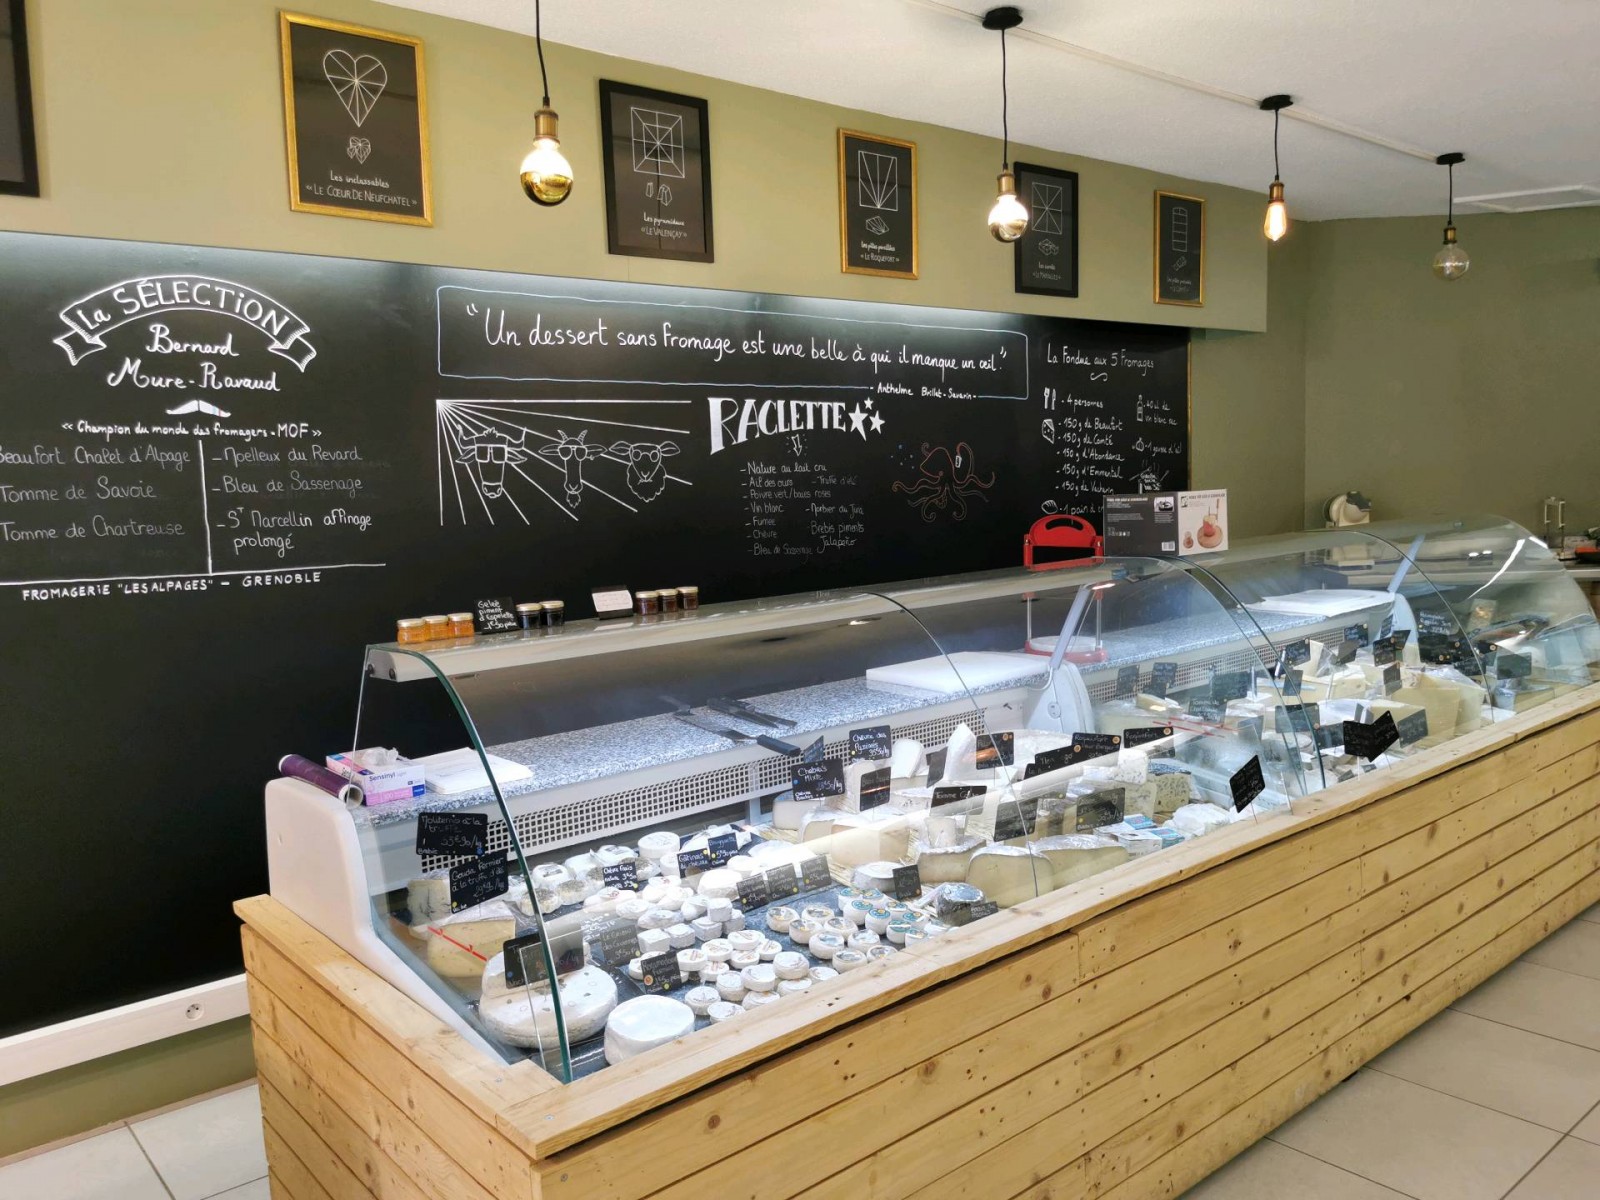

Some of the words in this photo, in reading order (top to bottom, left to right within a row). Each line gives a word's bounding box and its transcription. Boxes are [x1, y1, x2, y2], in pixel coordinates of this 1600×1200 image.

[330, 170, 343, 182] Les
[346, 175, 390, 188] inclassables
[352, 190, 363, 201] DE
[77, 305, 111, 331] La
[146, 324, 239, 356] Bernard
[529, 313, 608, 346] dessert
[616, 329, 657, 347] sans
[662, 322, 736, 362] fromage
[743, 330, 765, 354] est
[772, 341, 806, 358] une
[810, 336, 850, 361] belle
[852, 344, 866, 361] à
[870, 350, 891, 374] qui
[899, 344, 909, 362] il
[912, 352, 958, 383] manque
[961, 358, 976, 370] un
[1047, 343, 1059, 363] La
[1063, 346, 1091, 366] Fondue
[1094, 356, 1107, 366] aux
[1111, 353, 1118, 367] 5
[1121, 348, 1154, 376] Fromages
[877, 382, 914, 396] Anthelme
[1067, 393, 1072, 403] 4
[1162, 401, 1171, 411] de
[707, 397, 846, 455] RACLETTE
[1084, 418, 1092, 430] de
[1094, 416, 1123, 432] Beaufort
[1154, 415, 1167, 424] blanc
[77, 420, 131, 441] Champion
[135, 423, 149, 434] du
[151, 425, 189, 436] monde
[192, 423, 210, 435] des
[213, 423, 268, 441] fromagers
[278, 422, 309, 439] MOF
[1083, 434, 1092, 445] de
[1093, 434, 1114, 446] Comté
[74, 446, 120, 465] Chalet
[129, 445, 190, 472] d'Alpage
[225, 446, 280, 472] Moelleux
[288, 448, 307, 461] du
[311, 445, 363, 461] Revard
[747, 461, 776, 475] Nature
[794, 462, 811, 474] lait
[814, 463, 827, 472] cru
[0, 485, 60, 503] Tomme
[65, 485, 87, 500] de
[96, 475, 157, 500] Savoie
[223, 475, 259, 493] Bleu
[266, 480, 285, 493] de
[290, 470, 363, 498] Sassenage
[749, 476, 762, 488] Ail
[765, 477, 776, 488] des
[777, 479, 793, 488] ours
[1080, 482, 1089, 493] de
[750, 490, 773, 500] Poivre
[815, 489, 832, 498] roses
[750, 502, 763, 514] Vin
[764, 502, 785, 514] blanc
[811, 503, 836, 517] Morbier
[839, 505, 848, 513] du
[850, 503, 864, 519] Jura
[1071, 503, 1088, 515] pain
[252, 510, 313, 529] Marcellin
[323, 508, 373, 532] affinage
[0, 521, 59, 542] Tomme
[65, 522, 87, 539] de
[92, 515, 185, 537] Chartreuse
[752, 529, 777, 540] Chèvre
[810, 520, 835, 535] Brebis
[838, 522, 864, 538] piments
[234, 532, 295, 558] prolongé
[753, 543, 772, 556] Bleu
[773, 546, 781, 554] de
[242, 572, 321, 588] GRENOBLE
[478, 600, 501, 608] Gelée
[369, 772, 396, 782] Sensinyl
